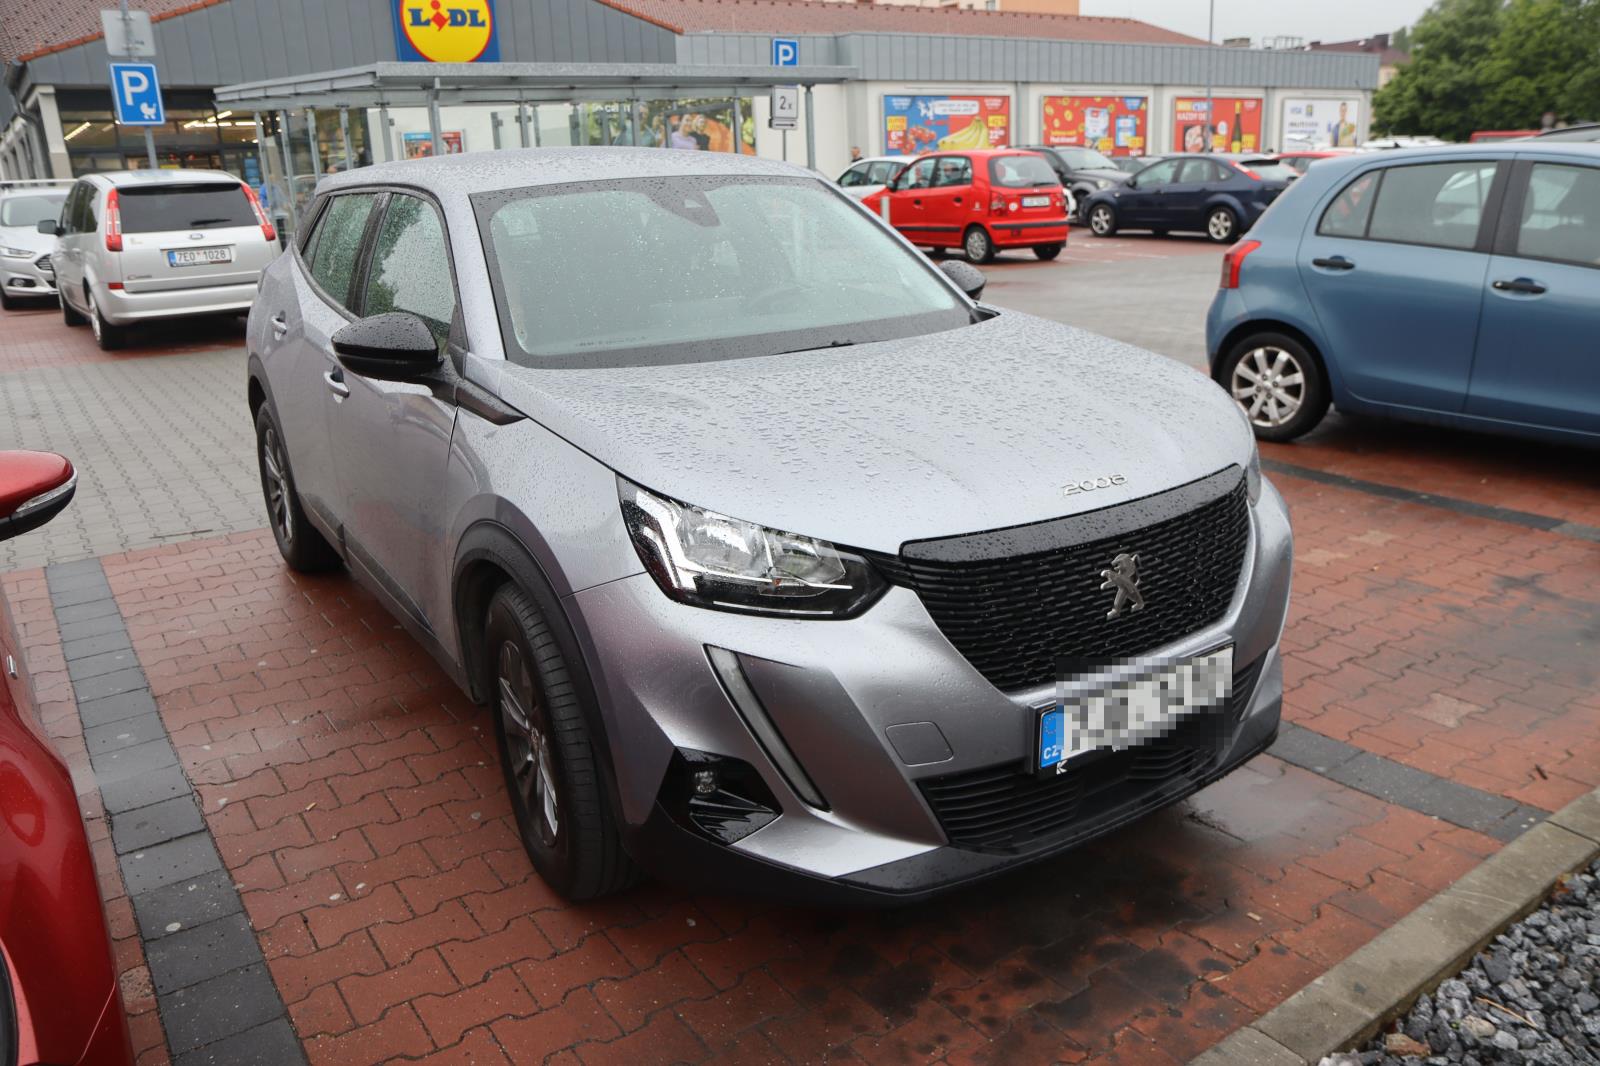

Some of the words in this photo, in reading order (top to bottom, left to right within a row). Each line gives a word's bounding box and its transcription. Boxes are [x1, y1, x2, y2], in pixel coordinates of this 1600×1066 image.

[779, 44, 793, 66] P
[121, 70, 148, 106] P
[203, 250, 226, 260] 1028
[1061, 473, 1128, 496] 2008
